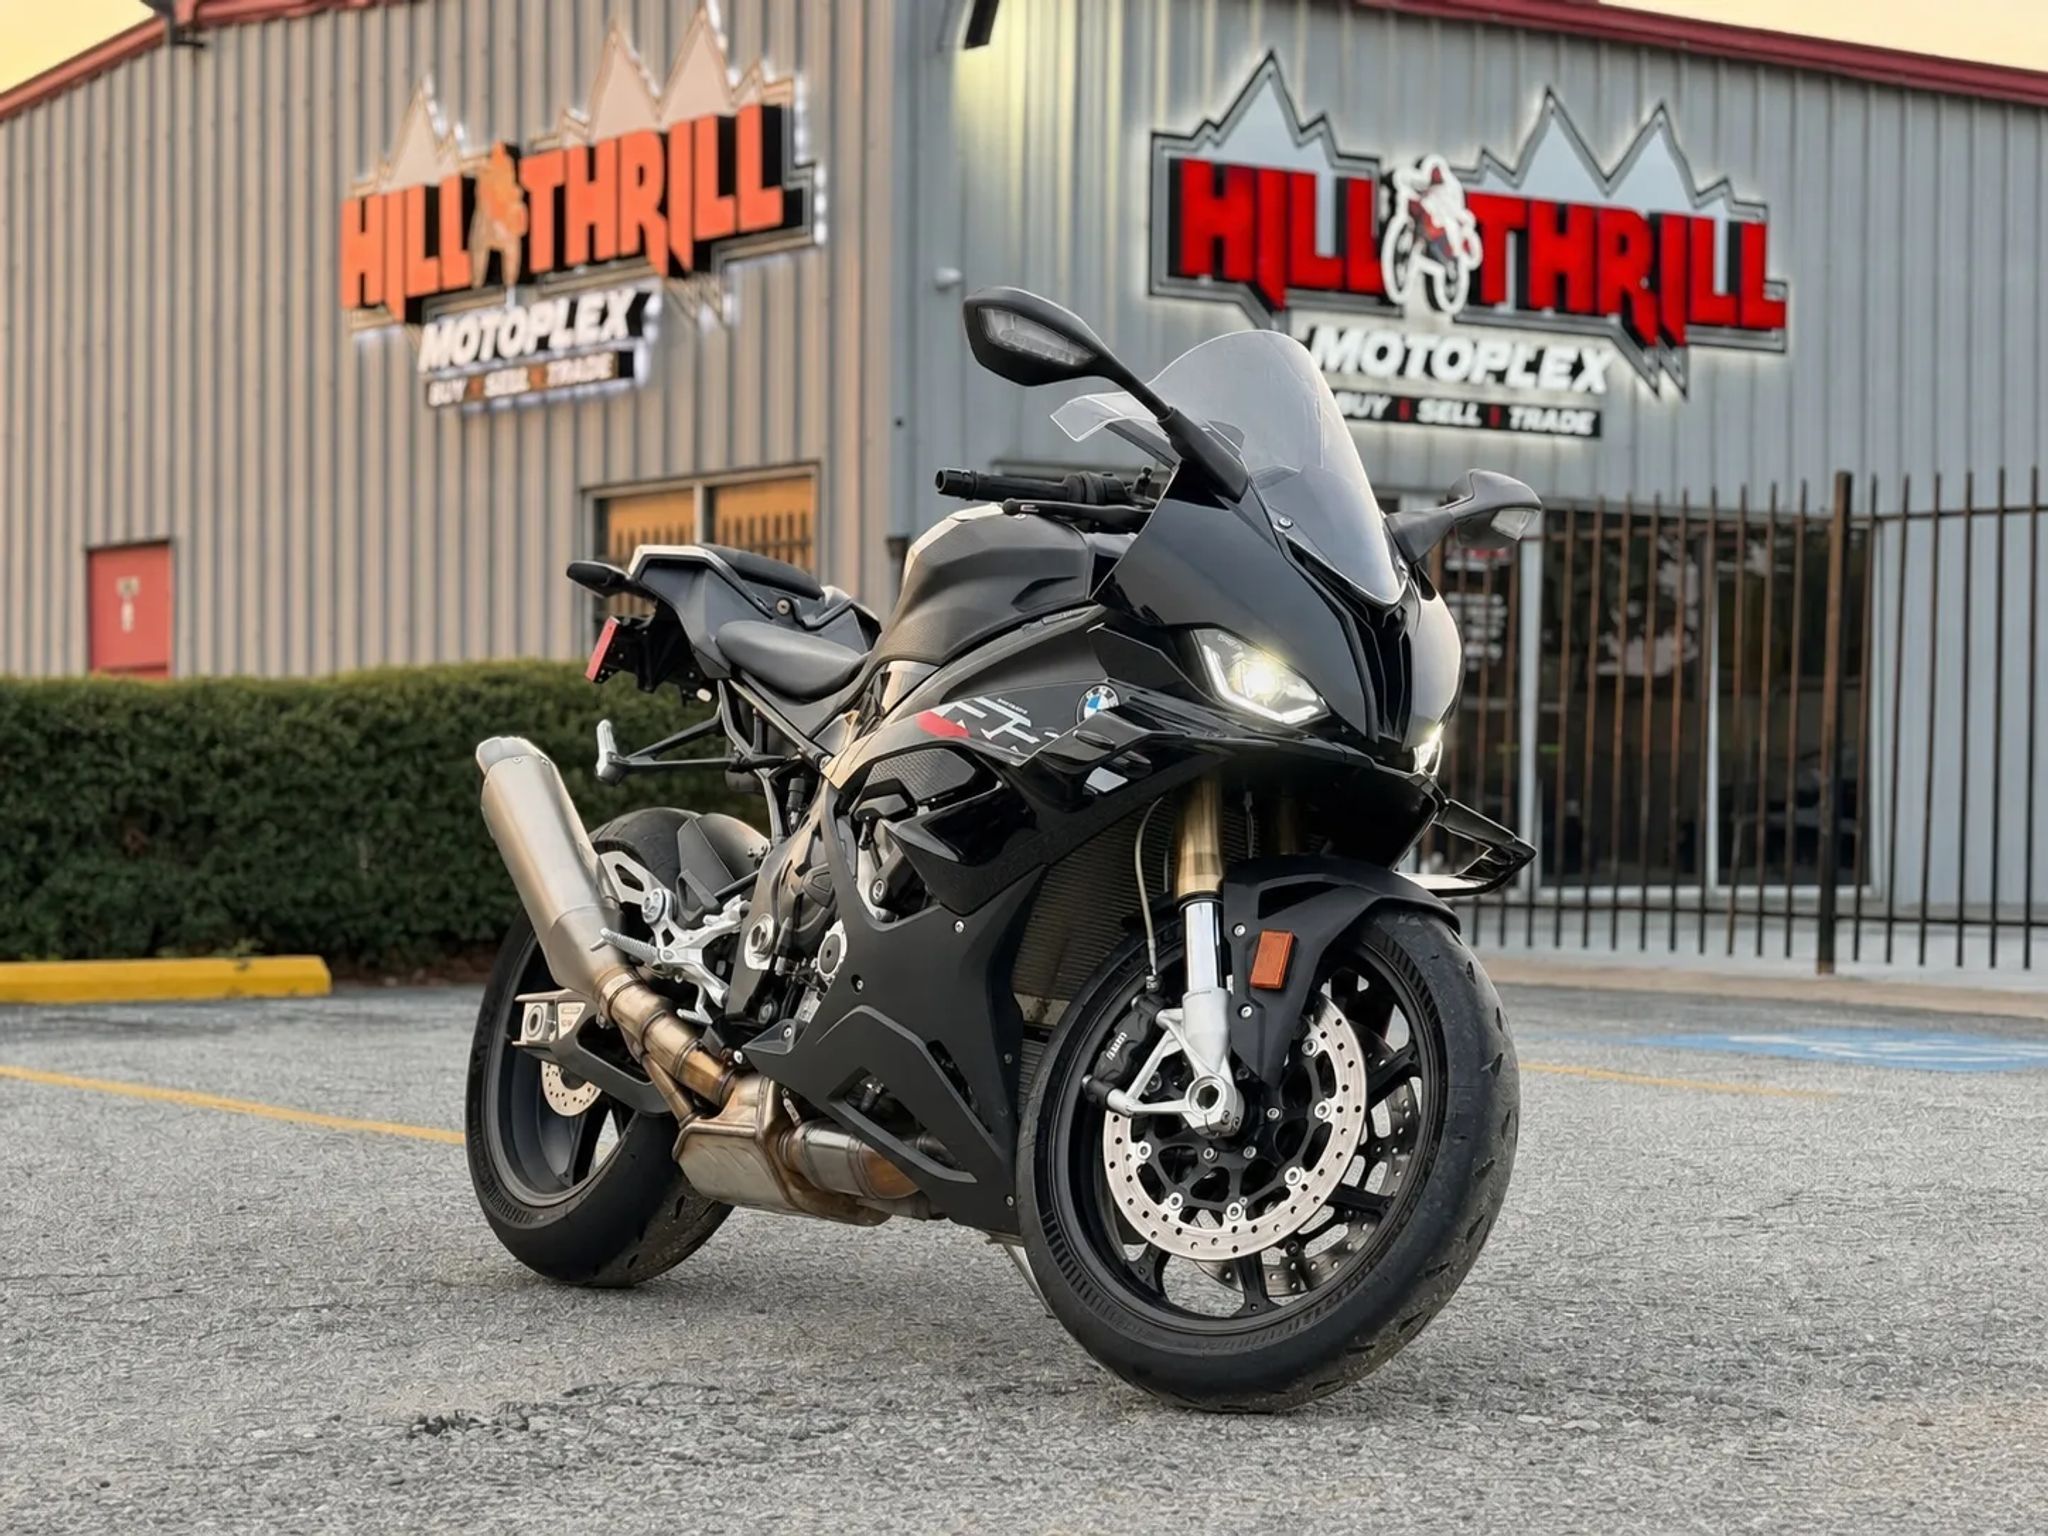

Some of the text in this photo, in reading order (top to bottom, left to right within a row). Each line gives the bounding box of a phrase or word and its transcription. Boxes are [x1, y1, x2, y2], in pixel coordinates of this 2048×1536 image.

[341, 103, 783, 323] HILL THRILL
[1179, 157, 1787, 347] HILL THRILL
[418, 286, 637, 374] MOTOPLEX
[1311, 325, 1613, 394] MOTOPLEX
[428, 351, 615, 407] BUY SELL TRADE
[1333, 390, 1597, 435] BUY SELL TRADE
